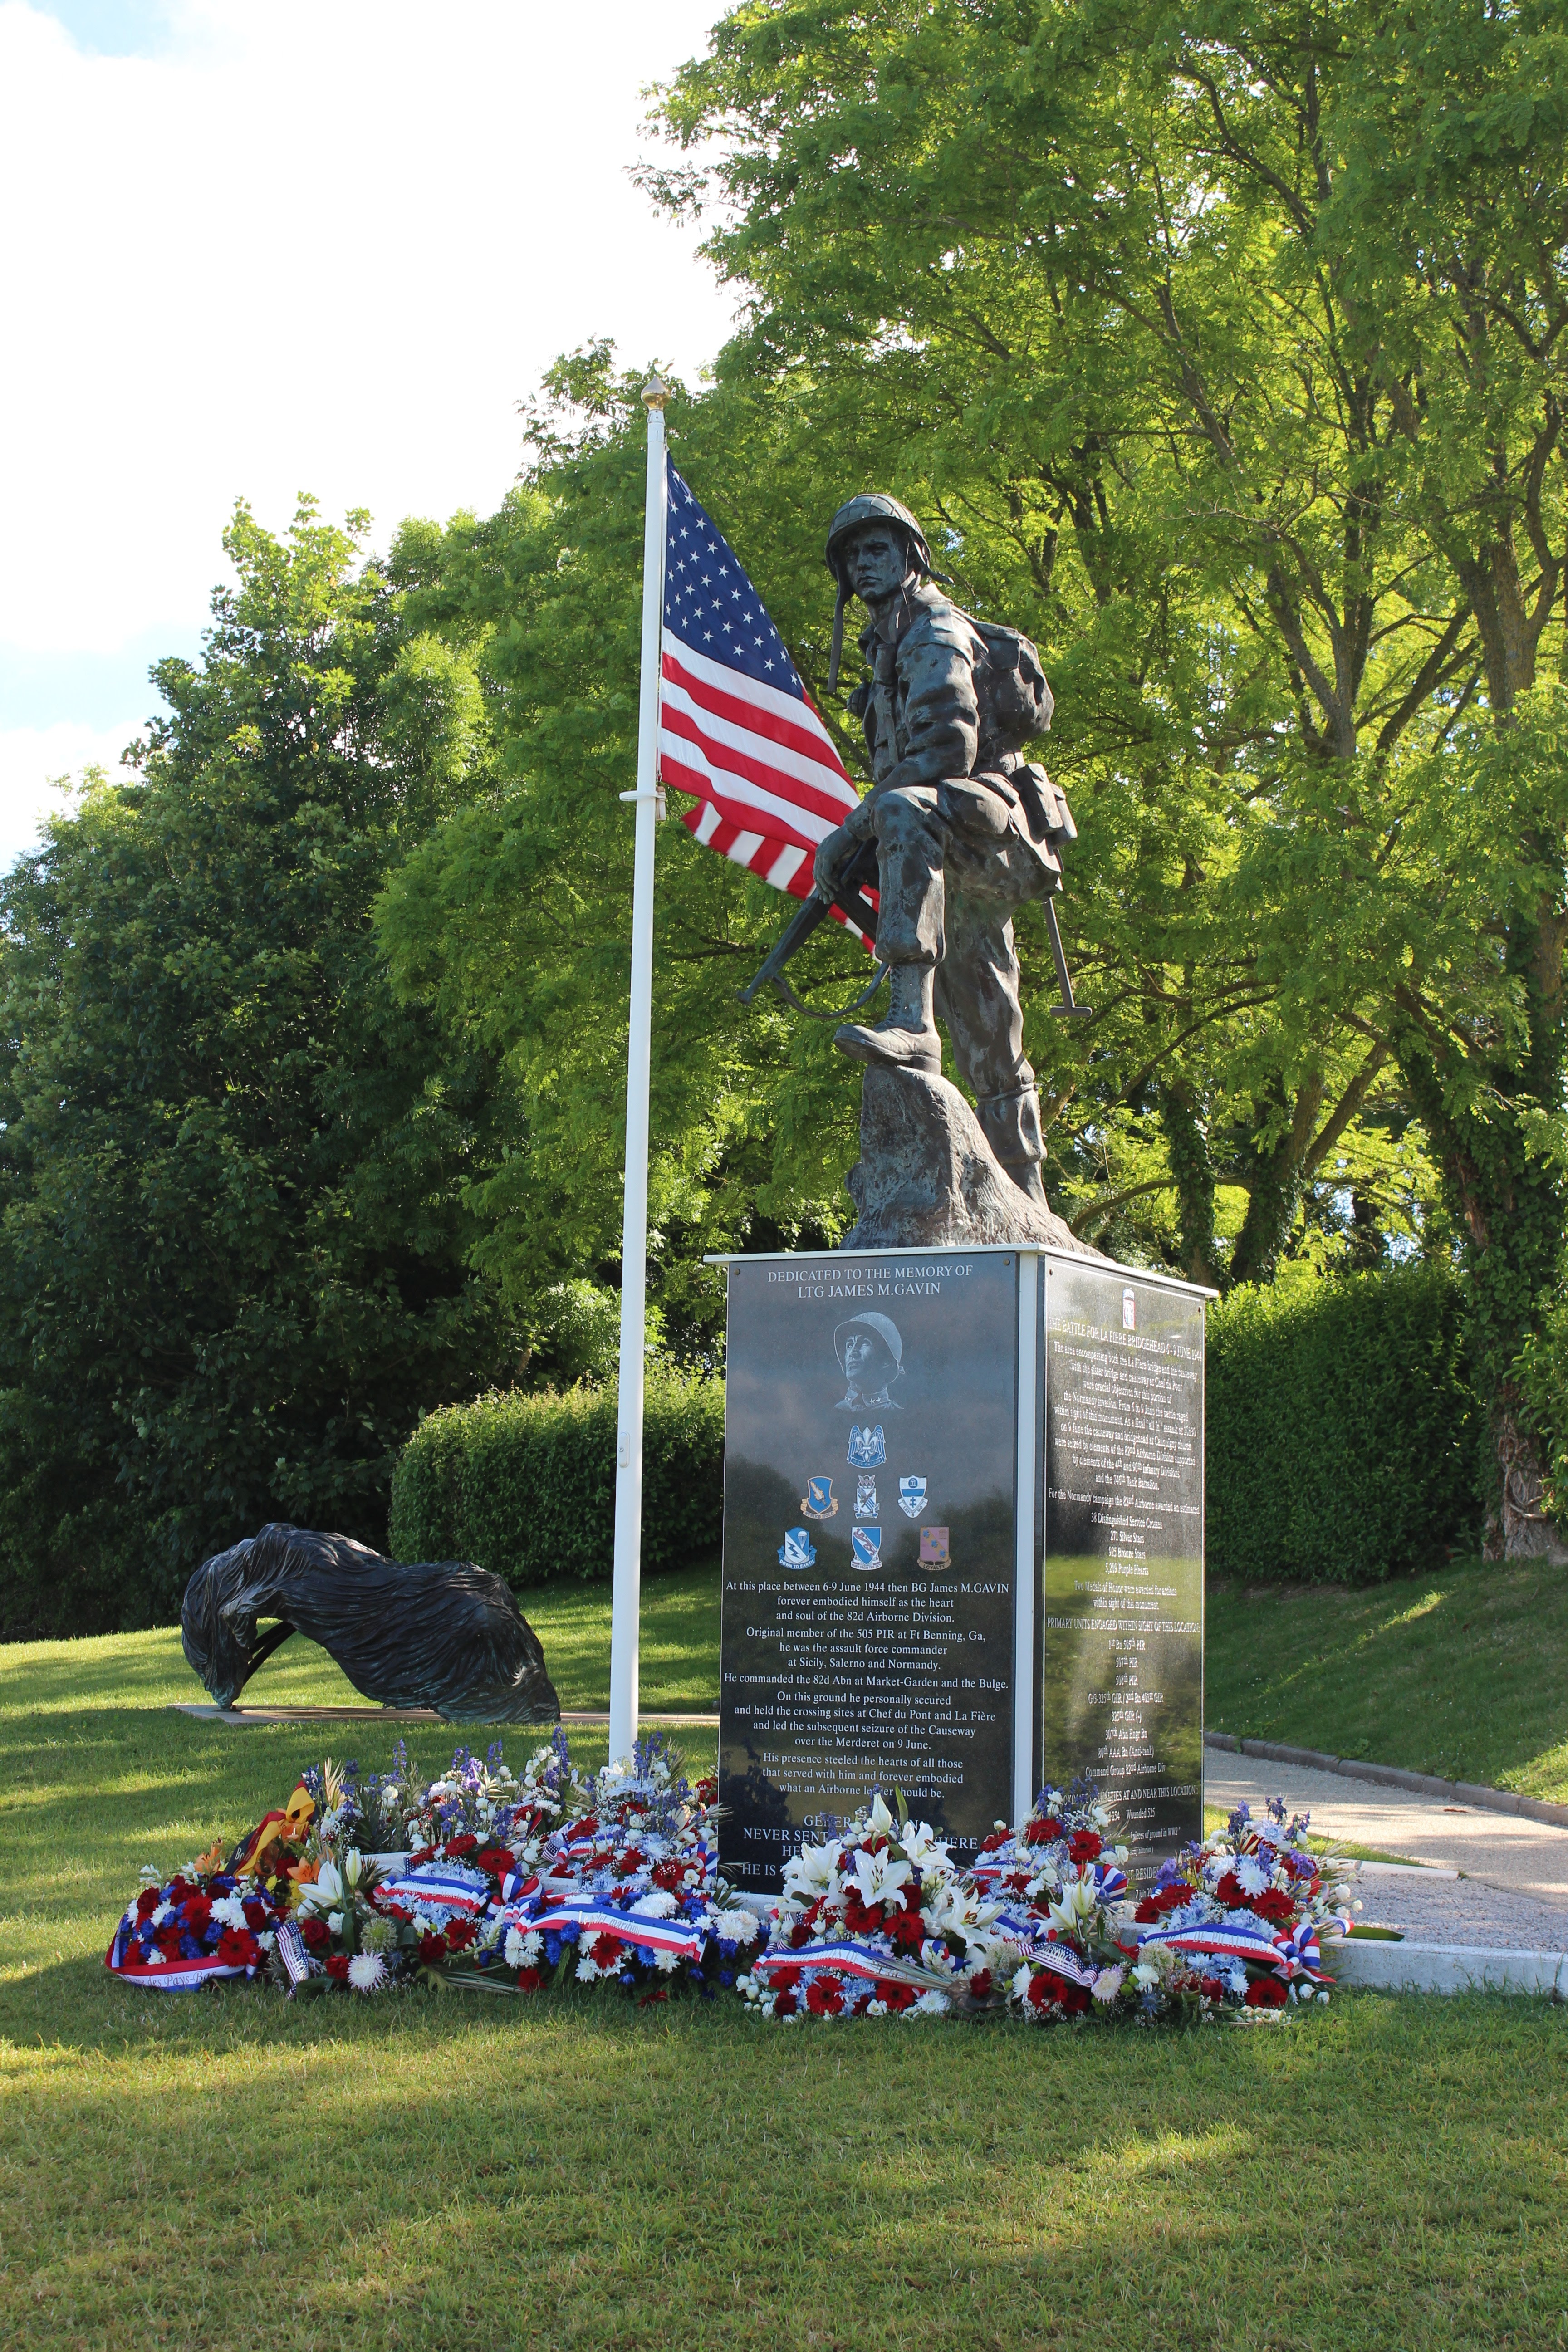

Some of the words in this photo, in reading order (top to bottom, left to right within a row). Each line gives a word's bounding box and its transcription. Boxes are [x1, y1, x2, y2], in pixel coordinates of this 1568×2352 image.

[768, 1269, 841, 1282] DEDICATED
[844, 1268, 862, 1280] TO
[865, 1268, 891, 1279] THE
[895, 1265, 953, 1278] MEMORY
[955, 1264, 973, 1276] OF
[798, 1285, 824, 1298] LTG
[828, 1284, 873, 1298] JAMES
[878, 1282, 941, 1296] M.GAVIN
[1091, 1512, 1097, 1523] 38
[1098, 1513, 1129, 1527] Distinguished
[1129, 1516, 1145, 1528] Service
[1110, 1530, 1118, 1541] 271
[1119, 1531, 1132, 1542] Silver
[1133, 1532, 1144, 1544] Stars
[779, 1559, 792, 1568] DOWN
[800, 1559, 814, 1568] EARTH
[725, 1580, 737, 1590] At
[740, 1580, 755, 1591] this
[758, 1581, 781, 1593] place
[784, 1581, 820, 1592] between
[823, 1581, 837, 1592] 6-9
[839, 1582, 861, 1592] June
[864, 1582, 885, 1592] 1944
[888, 1582, 908, 1592] then
[911, 1582, 927, 1592] BG
[929, 1583, 958, 1593] James
[960, 1583, 1009, 1593] M.GAVIN
[777, 1595, 811, 1606] forever
[813, 1596, 858, 1607] embodied
[861, 1596, 897, 1607] himself
[898, 1599, 908, 1607] as
[911, 1597, 926, 1607] the
[929, 1597, 954, 1608] heart
[776, 1610, 793, 1620] and
[795, 1610, 814, 1621] soul
[817, 1610, 828, 1621] of
[829, 1611, 844, 1621] the
[847, 1611, 863, 1621] 82d
[866, 1611, 910, 1622] Airborne
[912, 1611, 955, 1623] Division.
[1047, 1617, 1073, 1629] PRIMARY
[1073, 1618, 1090, 1629] UNITS
[1091, 1619, 1117, 1630] ENGAGED
[1118, 1620, 1138, 1631] WITHIN
[1138, 1621, 1153, 1631] SIGHT
[1154, 1621, 1161, 1632] OF
[1161, 1622, 1174, 1632] THIS
[746, 1627, 784, 1639] Original
[787, 1627, 824, 1638] member
[827, 1628, 838, 1638] of
[839, 1628, 854, 1638] the
[856, 1628, 873, 1639] 505
[876, 1629, 895, 1639] PIR
[897, 1631, 907, 1640] at
[910, 1629, 920, 1640] Ft
[923, 1629, 965, 1643] Benning,
[968, 1630, 986, 1643] Ga,
[788, 1658, 797, 1667] at
[799, 1656, 827, 1670] Sicily,
[829, 1657, 865, 1668] Salerno
[868, 1658, 885, 1669] and
[888, 1658, 941, 1672] Normandy.
[724, 1672, 737, 1682] He
[739, 1673, 794, 1684] commanded
[796, 1674, 811, 1685] the
[813, 1674, 829, 1685] 82d
[832, 1675, 852, 1686] Abn
[854, 1676, 863, 1686] at
[866, 1676, 938, 1688] Market-Garden
[941, 1677, 958, 1688] and
[961, 1677, 976, 1689] the
[979, 1678, 1009, 1691] Bulge.
[777, 1690, 791, 1701] On
[794, 1691, 811, 1701] this
[813, 1692, 847, 1705] ground
[849, 1692, 861, 1703] he
[863, 1694, 912, 1707] personally
[914, 1692, 951, 1705] secured
[734, 1705, 751, 1715] and
[754, 1705, 774, 1715] held
[776, 1705, 791, 1717] the
[794, 1706, 831, 1720] crossing
[833, 1707, 854, 1718] sites
[857, 1709, 867, 1718] at
[869, 1708, 892, 1719] Chef
[894, 1709, 906, 1720] du
[909, 1709, 931, 1720] Pont
[934, 1710, 951, 1720] and
[955, 1710, 967, 1721] La
[970, 1710, 996, 1722] Fière
[794, 1738, 816, 1746] over
[818, 1736, 833, 1747] the
[836, 1737, 880, 1749] Merderet
[882, 1740, 896, 1749] on
[897, 1739, 903, 1749] 9
[905, 1739, 931, 1750] June.
[763, 1752, 779, 1763] His
[781, 1755, 822, 1765] presence
[824, 1754, 858, 1765] steeled
[861, 1755, 876, 1766] the
[878, 1756, 907, 1767] hearts
[910, 1757, 921, 1768] of
[923, 1757, 935, 1768] all
[937, 1758, 963, 1769] those
[763, 1767, 780, 1777] that
[783, 1769, 813, 1779] served
[815, 1769, 835, 1779] with
[838, 1769, 856, 1780] him
[859, 1770, 876, 1781] and
[879, 1770, 914, 1782] forever
[916, 1773, 963, 1784] embodied
[779, 1783, 801, 1793] what
[818, 1784, 860, 1794] Airborne
[863, 1786, 894, 1796] leer
[900, 1788, 927, 1798] hould
[931, 1788, 945, 1798] be.
[1126, 1808, 1147, 1820] Wounded
[743, 1828, 790, 1841] NEVER
[794, 1829, 829, 1843] SENT
[742, 1863, 760, 1875] HE
[765, 1864, 776, 1876] IS
[578, 1910, 588, 1925] Le
[1193, 1931, 1206, 1944] DE
[1210, 1931, 1273, 1955] PICAUVILLE
[148, 1975, 162, 1987] des
